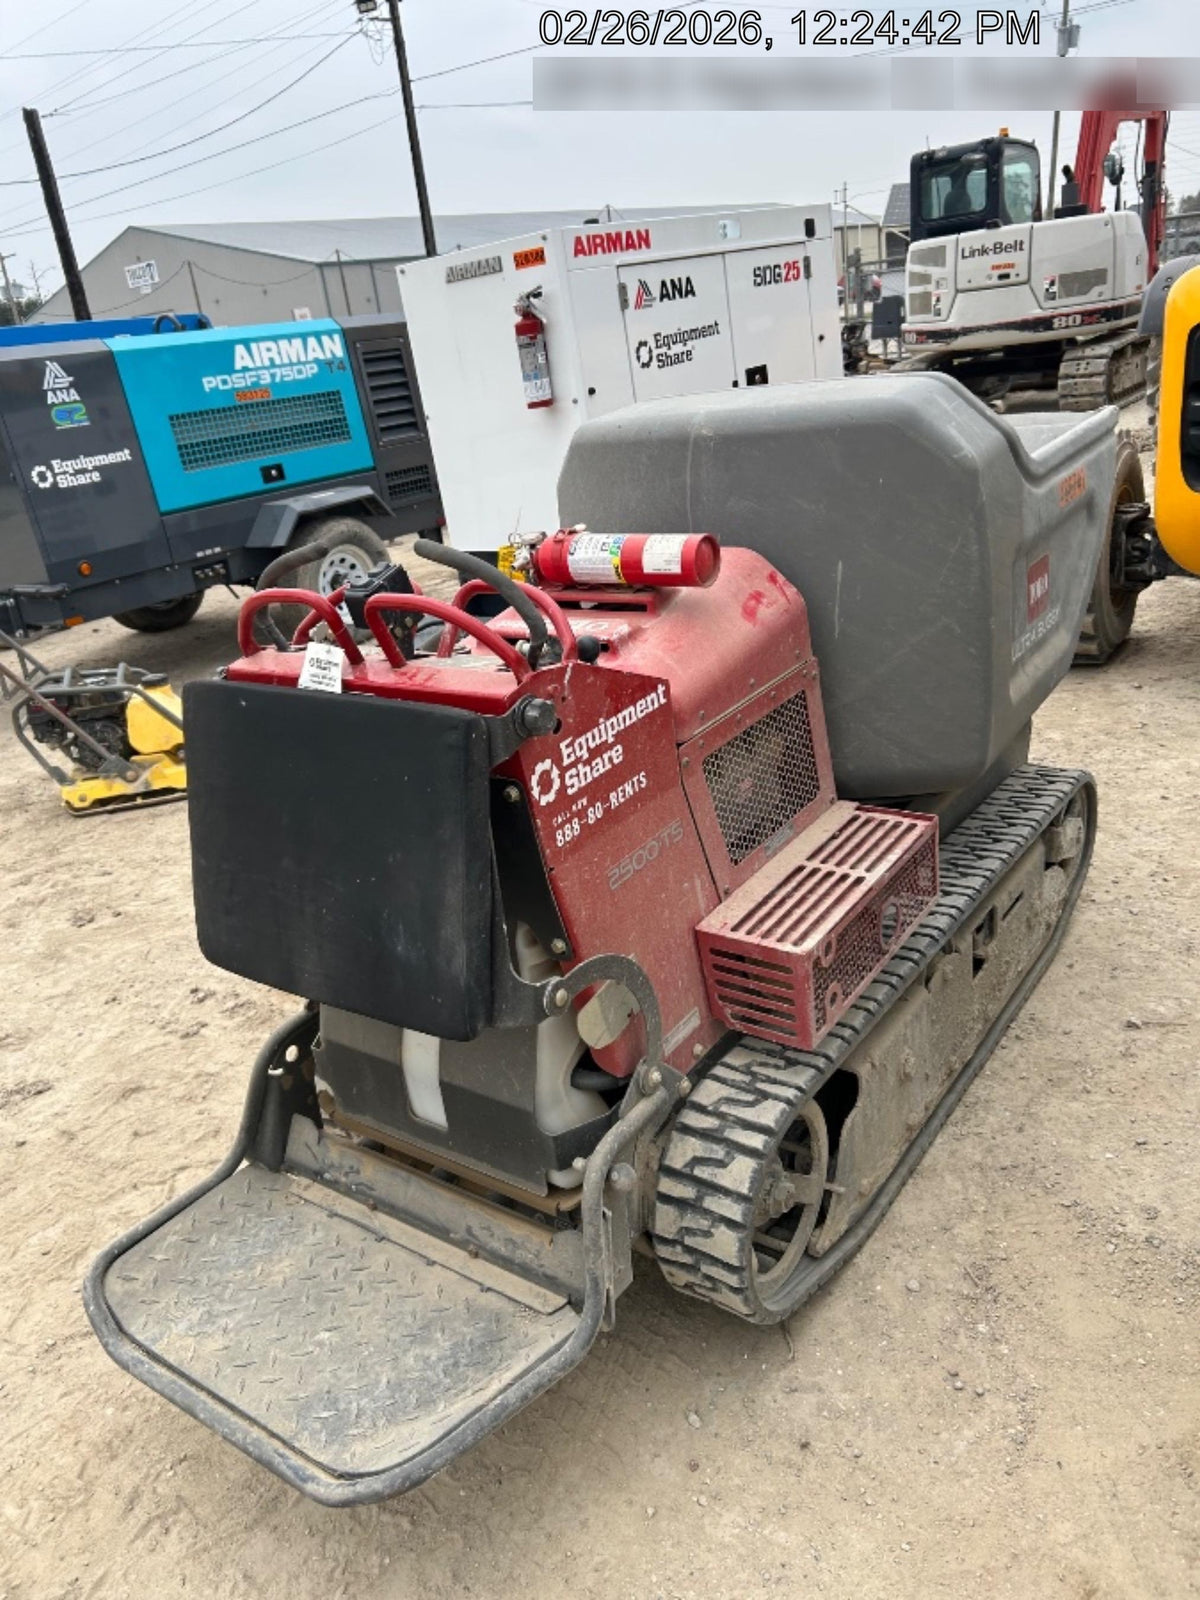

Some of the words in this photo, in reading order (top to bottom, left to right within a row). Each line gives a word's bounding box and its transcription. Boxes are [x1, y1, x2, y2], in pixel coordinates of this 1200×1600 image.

[573, 228, 651, 258] AIRMAN
[961, 239, 1024, 260] Link-Belt
[445, 256, 503, 284] AIRMAN
[752, 260, 801, 287] SDG25
[658, 276, 696, 303] ANA
[653, 320, 720, 351] Equipment
[233, 333, 344, 371] AIRMAN
[655, 349, 694, 370] Share
[201, 363, 318, 393] PDSF375DP
[47, 387, 81, 405] ANA
[51, 447, 132, 474] Equipment
[56, 470, 102, 488] Share
[559, 683, 668, 767] Equipment
[564, 744, 624, 796] Share
[555, 770, 648, 848] 888-80-RENTS
